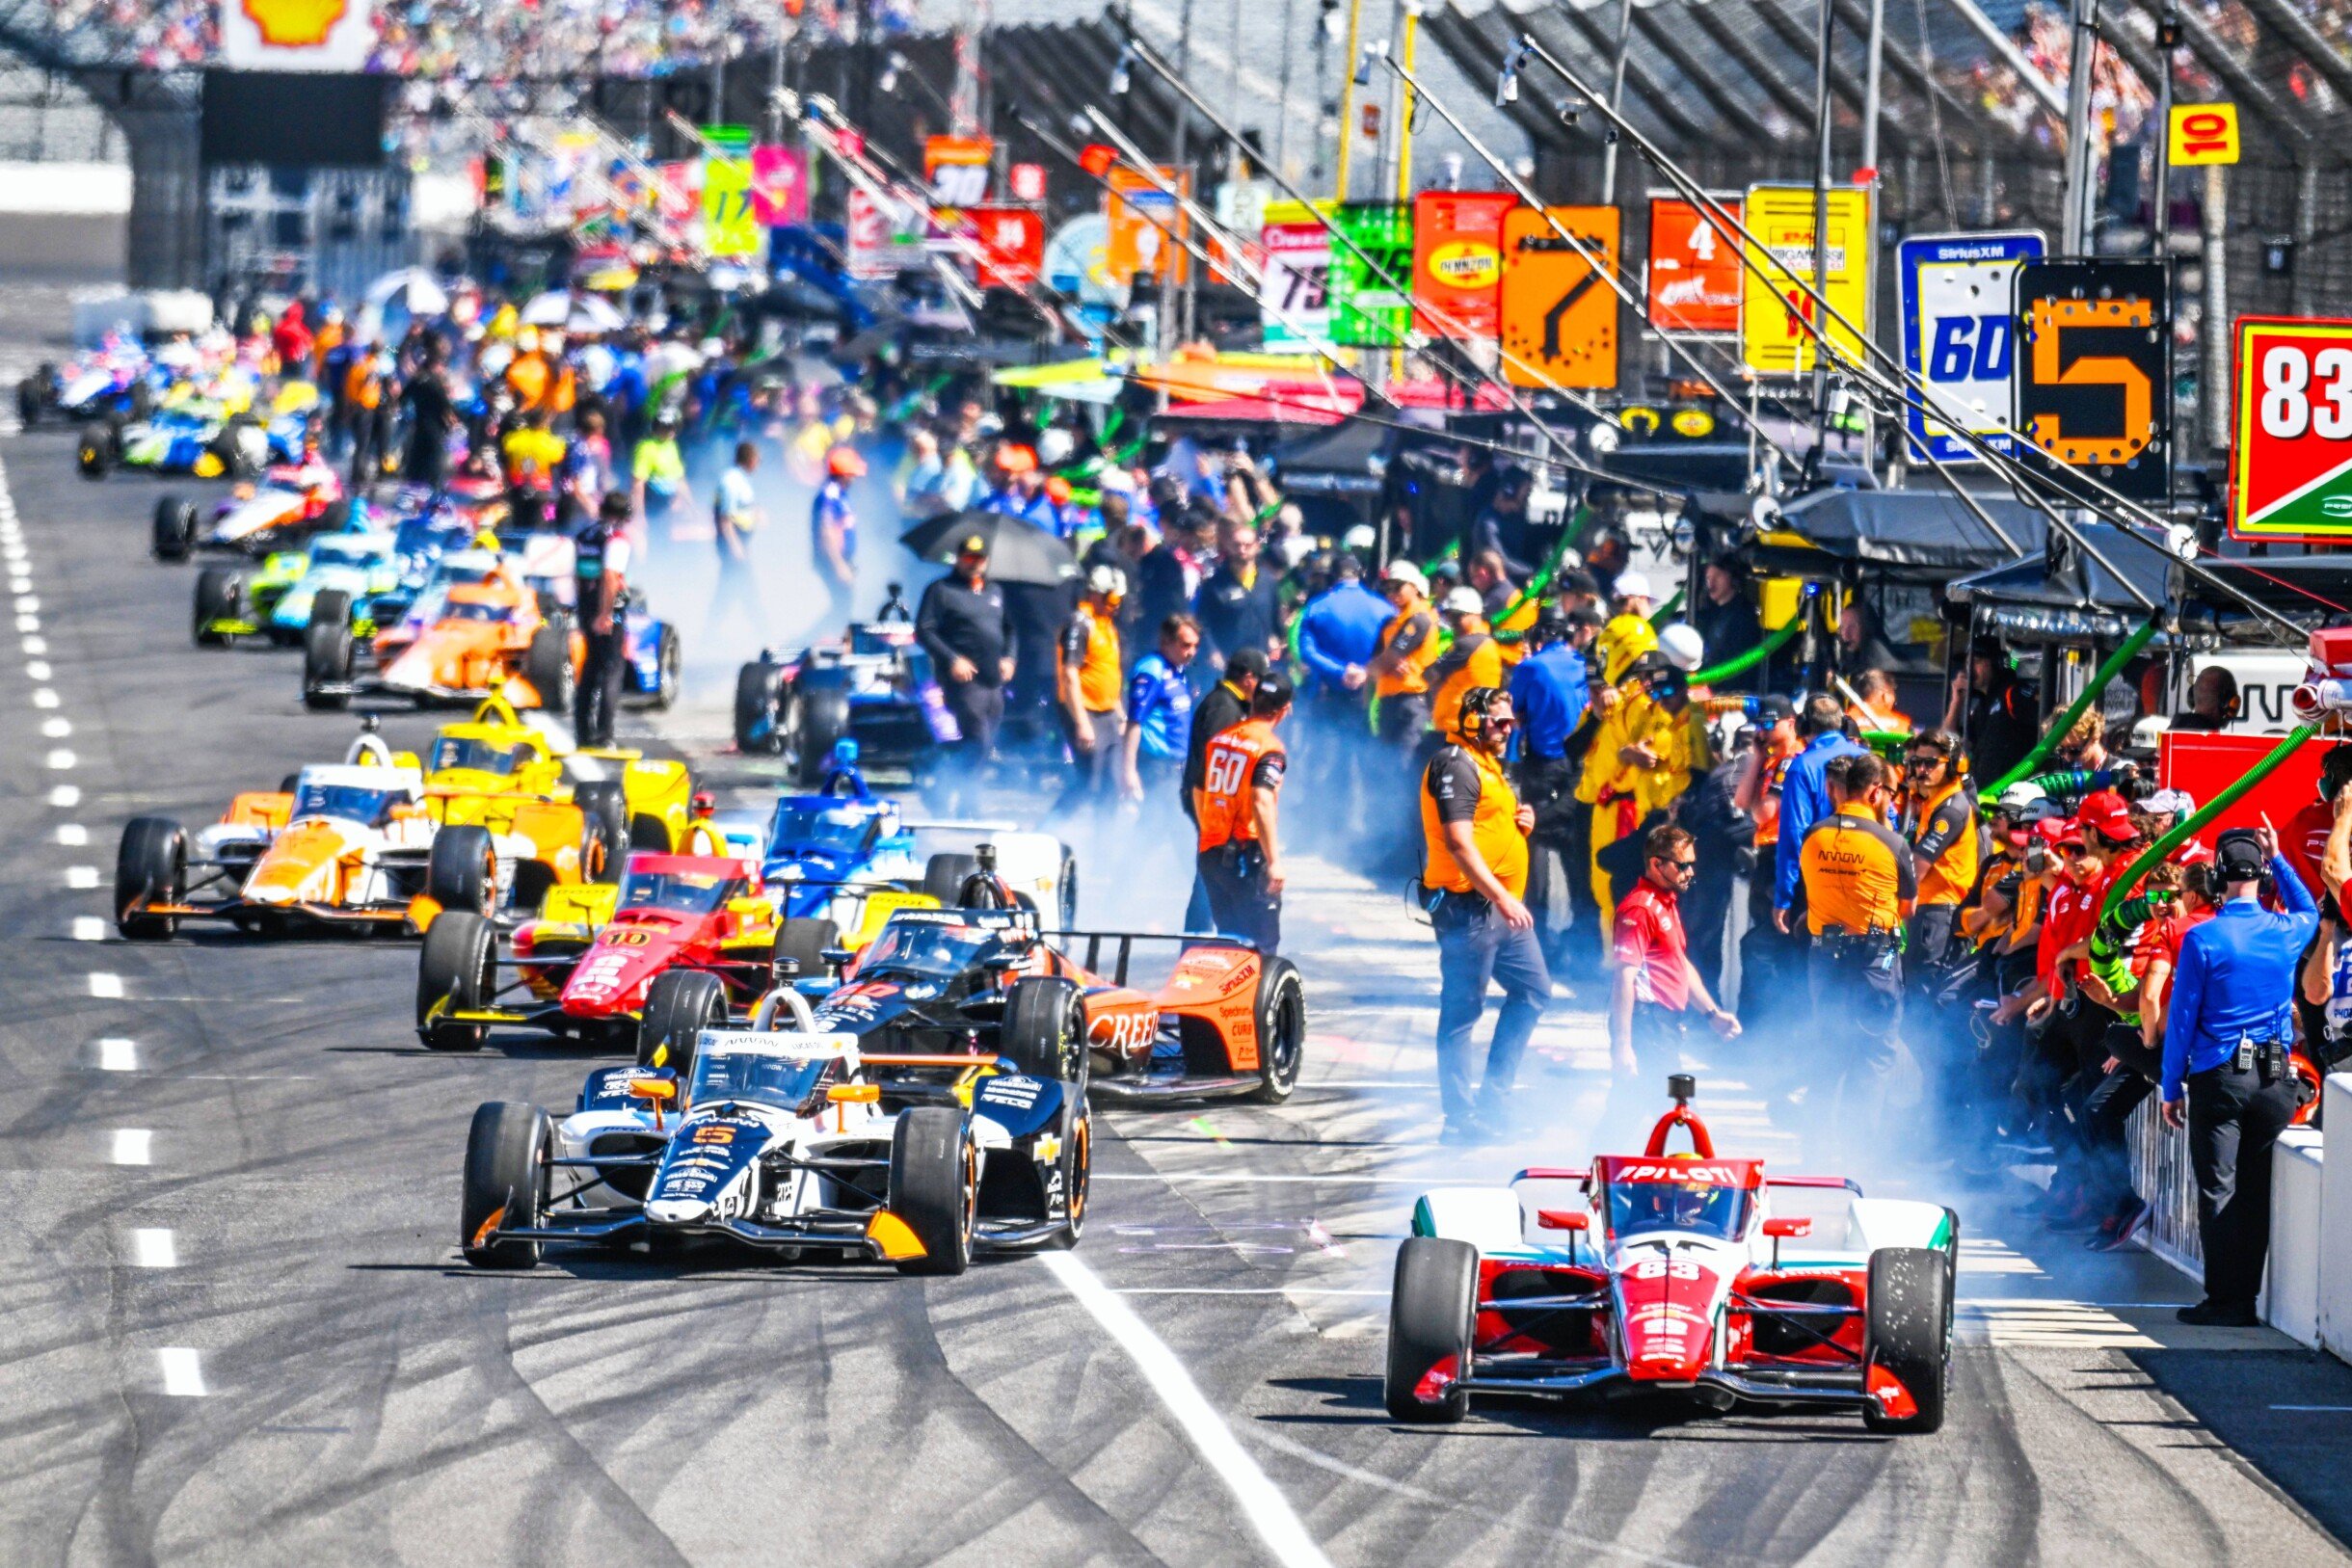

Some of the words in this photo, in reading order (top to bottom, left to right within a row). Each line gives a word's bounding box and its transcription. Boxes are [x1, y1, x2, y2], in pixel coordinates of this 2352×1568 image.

[2182, 114, 2228, 156] 10
[1688, 218, 1717, 260] 4
[1938, 246, 2005, 260] SiriusXM
[1517, 237, 1605, 358] 7
[1930, 314, 2011, 383] 60
[2033, 299, 2152, 465] 5
[2260, 346, 2352, 439] 83
[1208, 748, 1248, 796] 60
[1818, 850, 1866, 864] ARROW
[1818, 867, 1861, 877] McLaren
[1218, 964, 1256, 997] SiriusXM
[692, 1126, 736, 1145] 5
[1632, 1165, 1728, 1184] PILOT
[1637, 1261, 1700, 1281] 83
